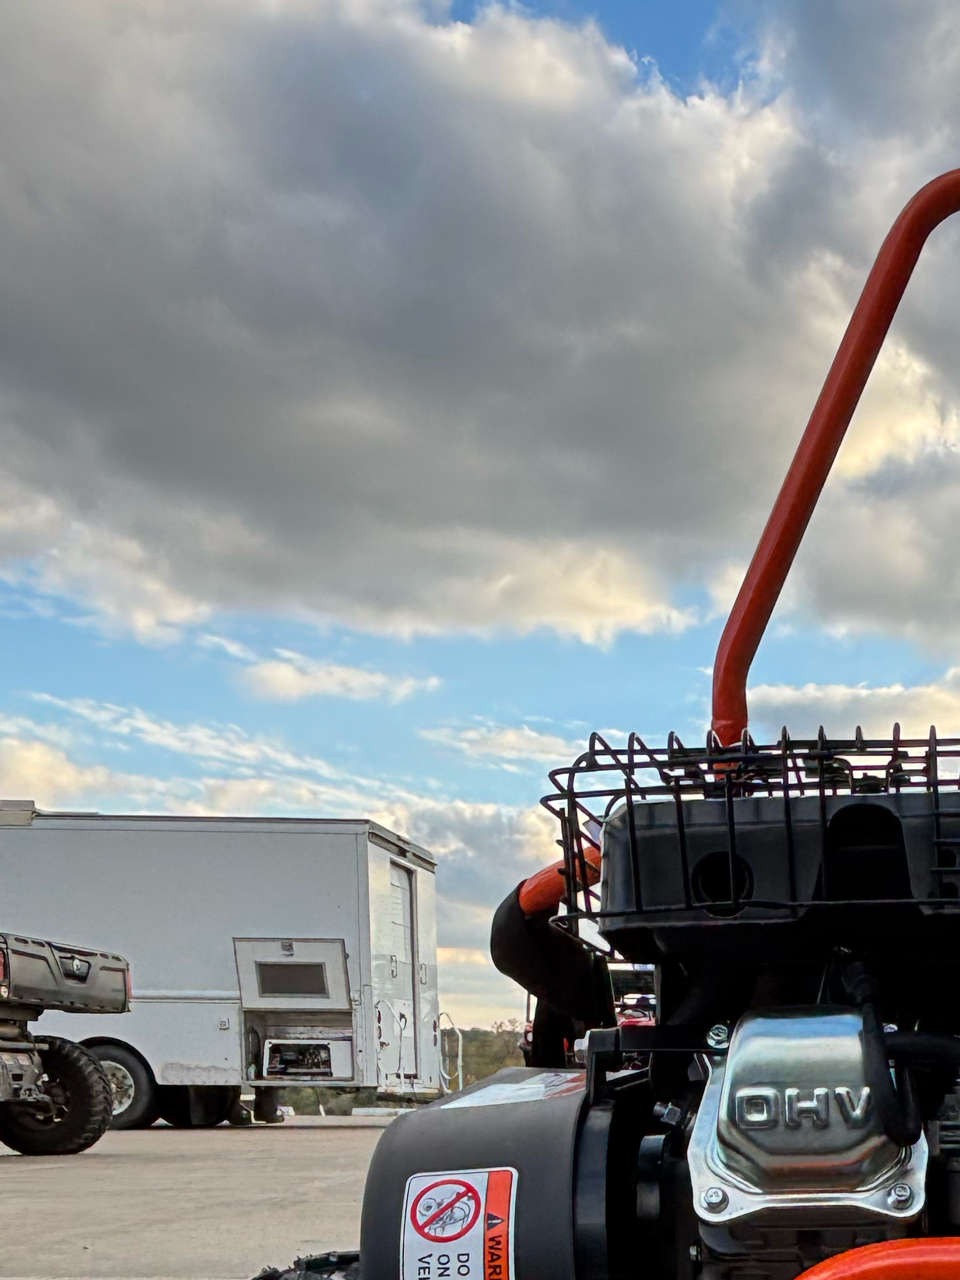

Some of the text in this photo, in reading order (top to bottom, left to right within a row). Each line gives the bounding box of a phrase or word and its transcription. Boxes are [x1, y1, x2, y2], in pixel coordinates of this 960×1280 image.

[736, 1087, 872, 1129] OHV
[437, 1253, 450, 1277] ON
[457, 1253, 470, 1276] DO
